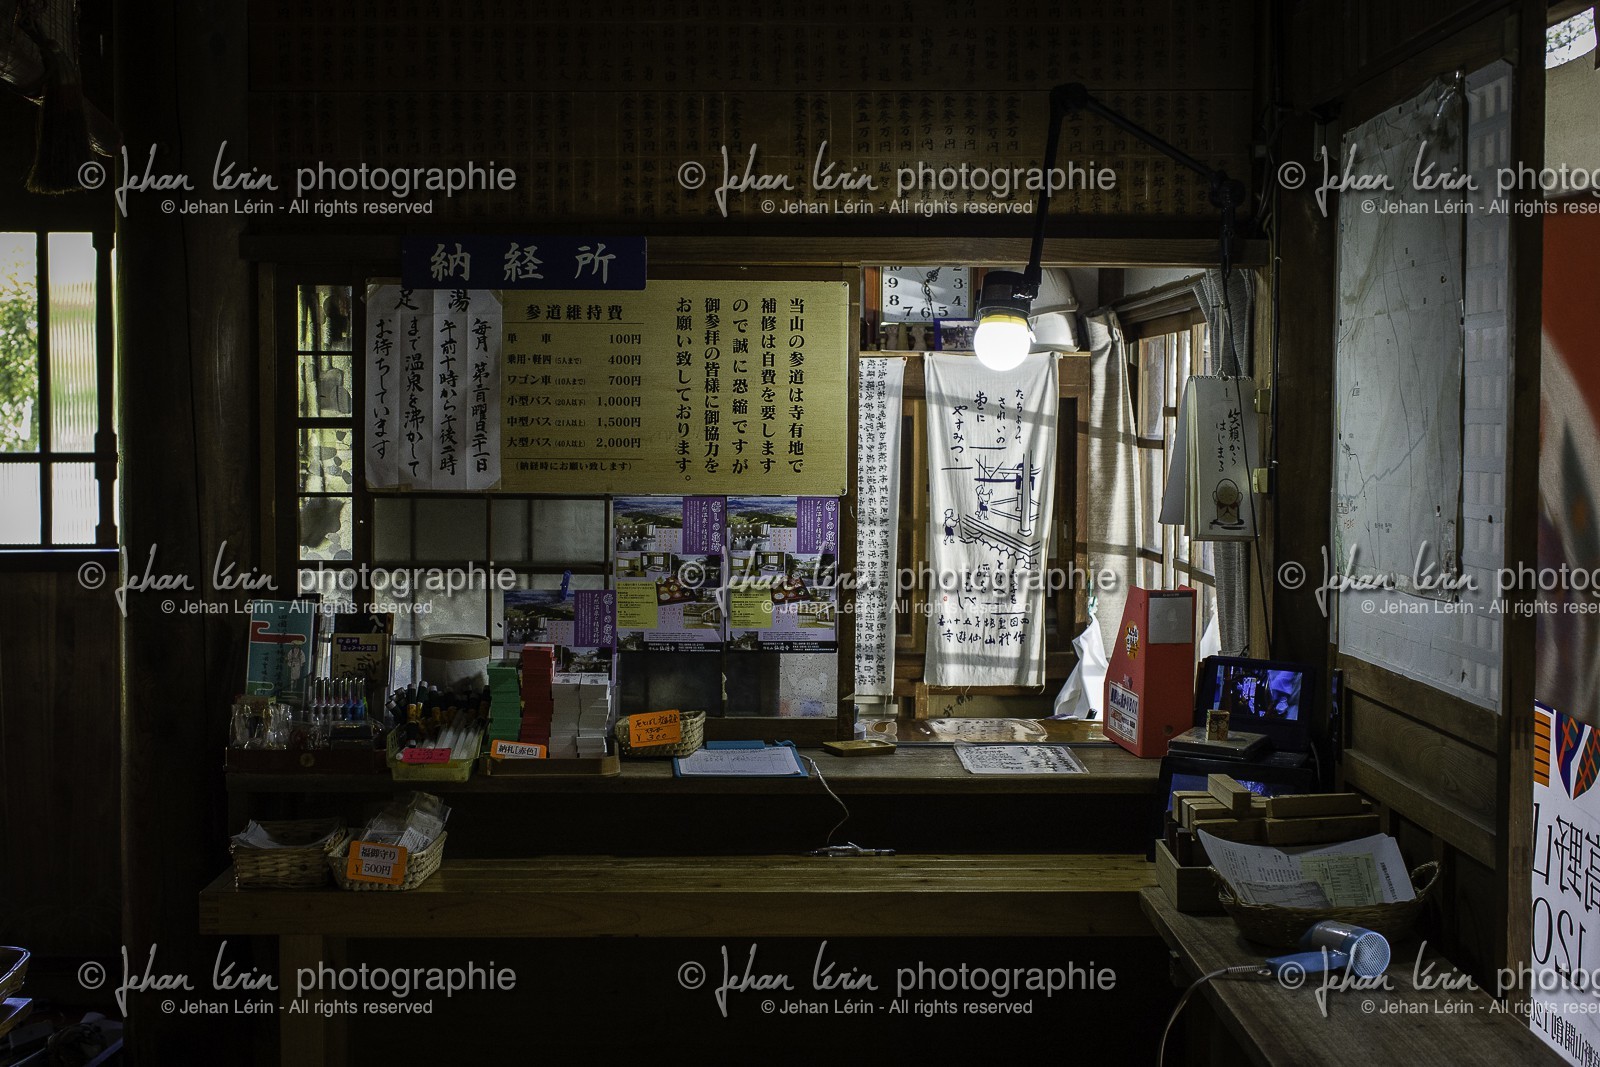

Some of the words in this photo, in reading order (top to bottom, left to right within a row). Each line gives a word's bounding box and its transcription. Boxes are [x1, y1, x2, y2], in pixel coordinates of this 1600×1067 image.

[430, 242, 617, 284] 納経所
[888, 277, 898, 288] 9
[953, 278, 963, 289] 3
[889, 295, 900, 306] 8
[952, 296, 962, 306] 4
[526, 304, 623, 321] 参道維持費
[902, 306, 913, 317] 7
[920, 307, 931, 318] 6
[938, 306, 949, 317] 5
[609, 334, 641, 345] 100円
[608, 355, 641, 365] 400円
[507, 375, 551, 386] ワゴン車
[608, 375, 641, 386] 700円
[704, 297, 720, 474] 御参拝の皆様に御協力を
[760, 297, 777, 474] 補修は自費を要します
[788, 297, 804, 473] 当山の参道は寺有地で
[372, 318, 394, 460] お待ちしています
[675, 297, 692, 481] お願い致しております。
[732, 298, 748, 475] ので誠に恐縮ですが
[507, 396, 551, 407] 小型バス
[597, 396, 641, 407] 1,000円
[507, 417, 551, 427] 中型バス
[597, 417, 641, 428] 1,500円
[507, 437, 551, 448] 大型バス
[596, 437, 641, 448] 2,000円
[1227, 408, 1241, 466] 笑顔から
[1216, 419, 1227, 472] はじまる
[364, 863, 391, 875] 500円
